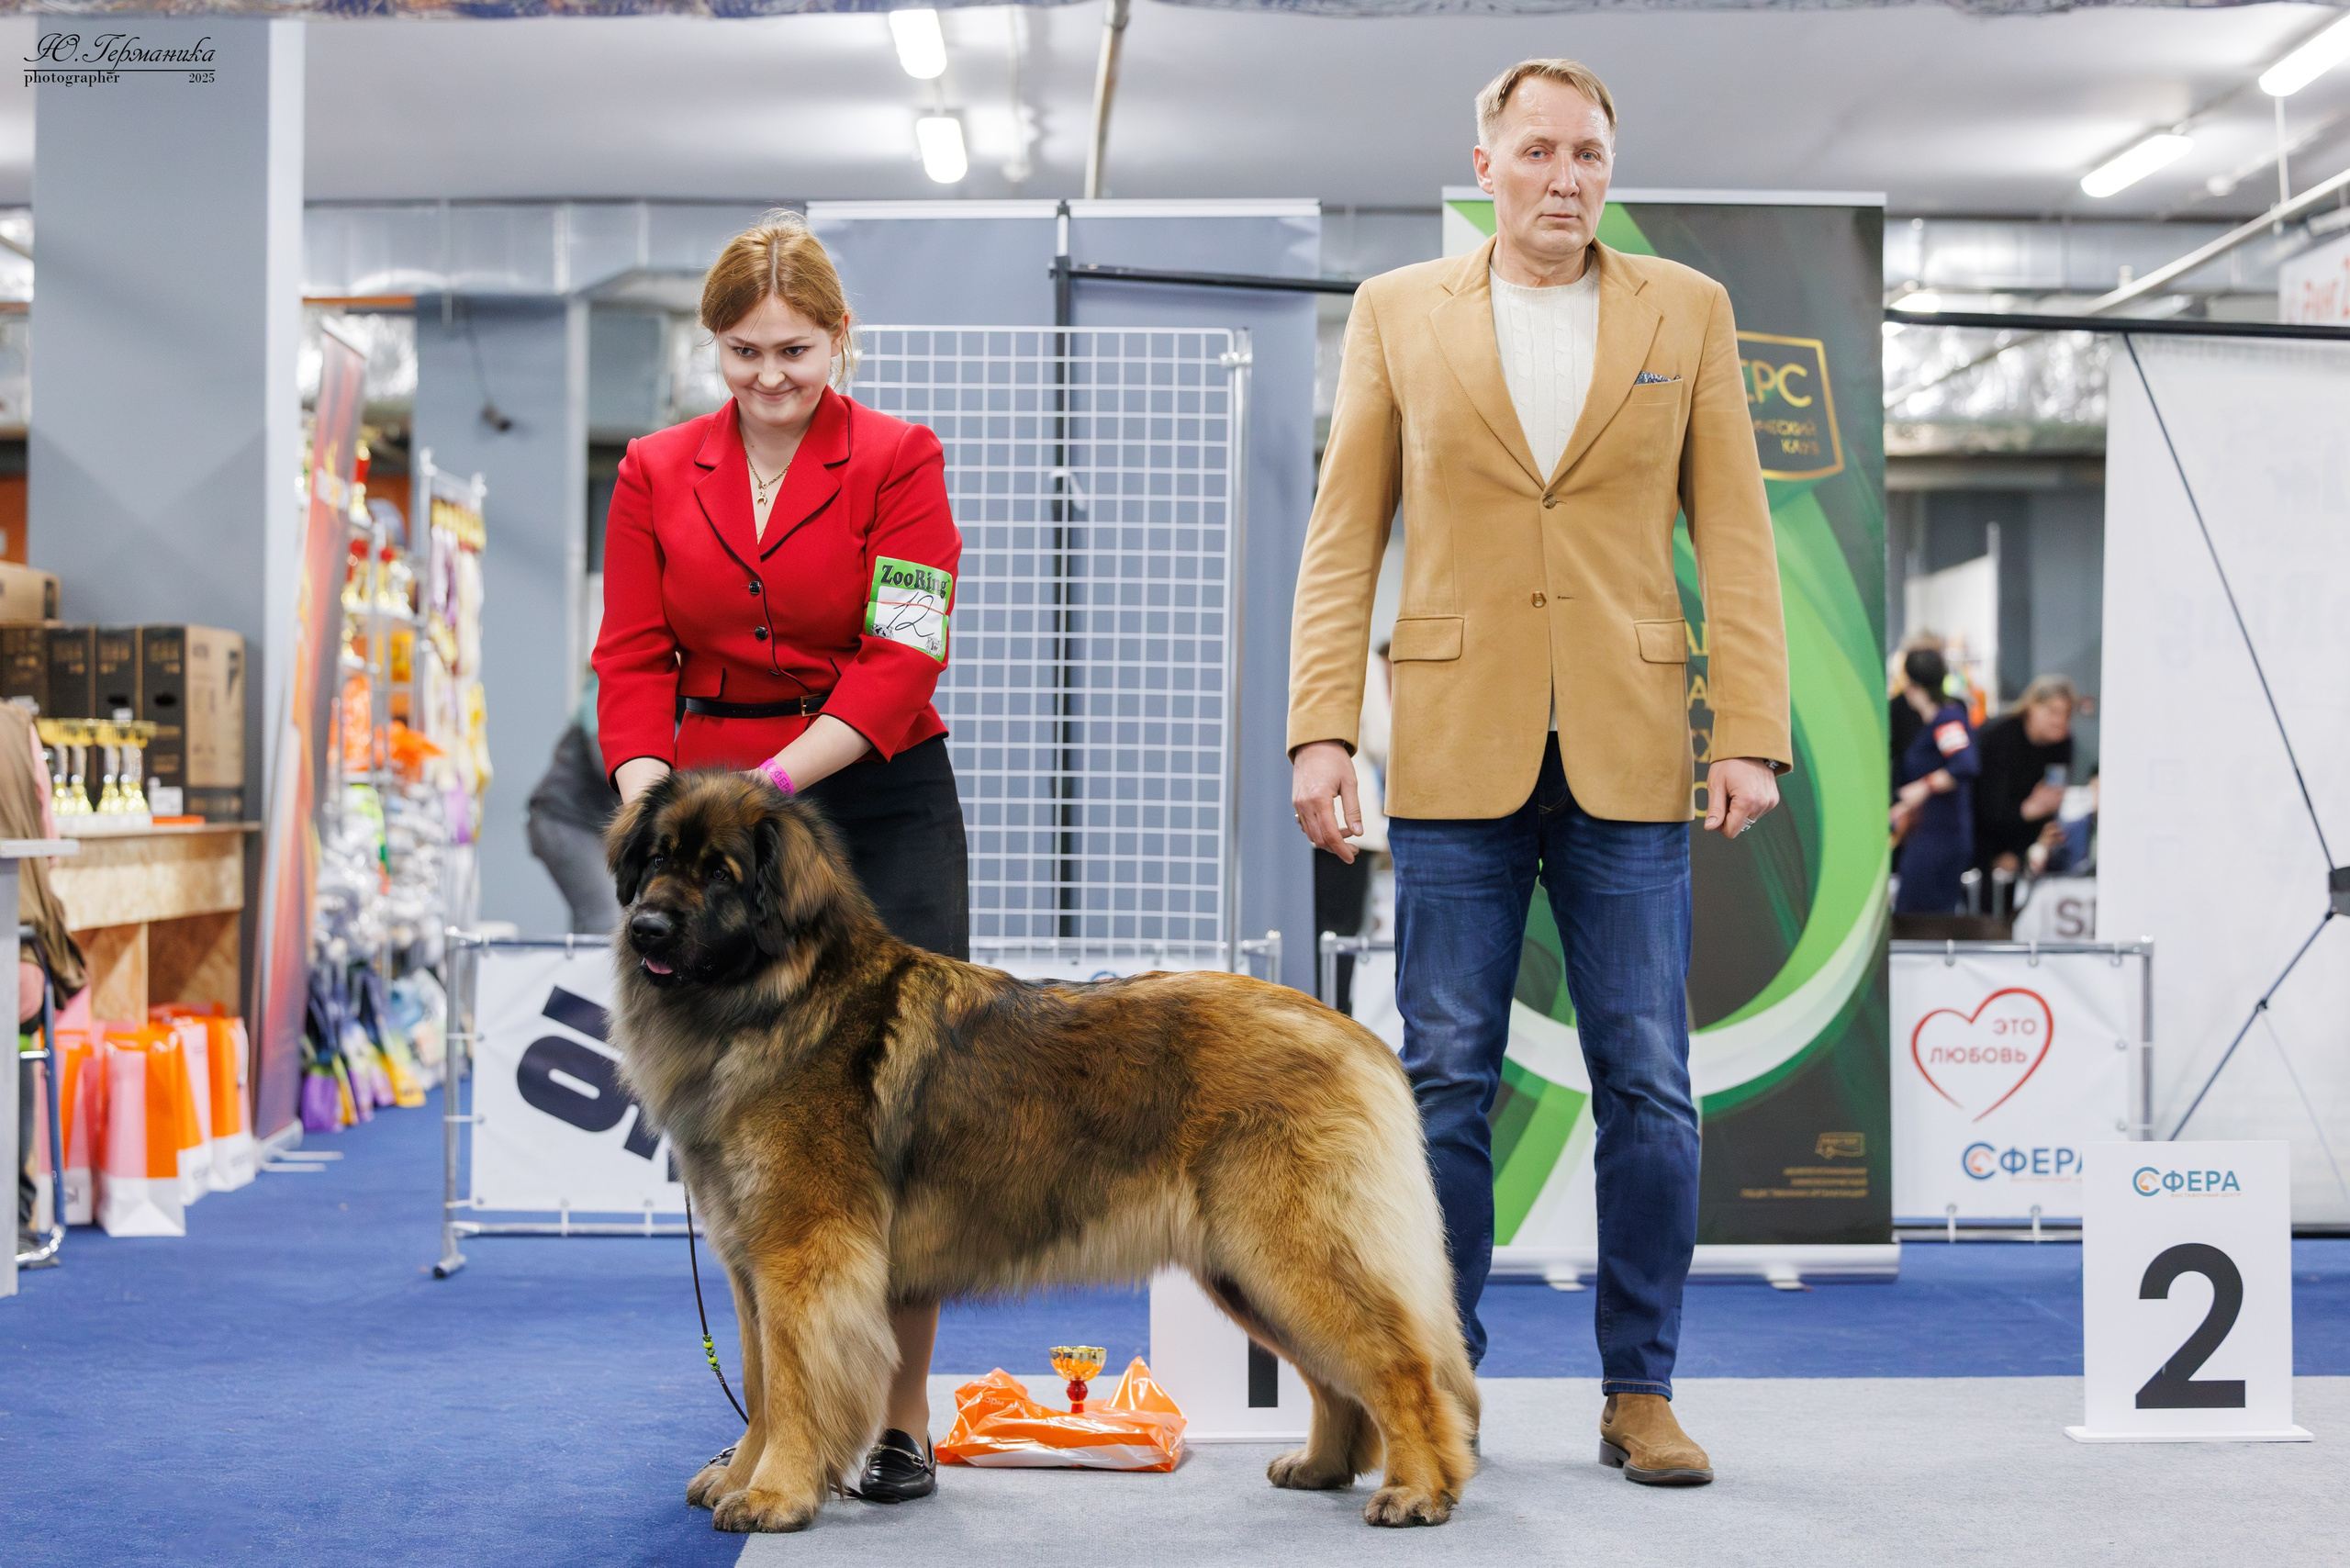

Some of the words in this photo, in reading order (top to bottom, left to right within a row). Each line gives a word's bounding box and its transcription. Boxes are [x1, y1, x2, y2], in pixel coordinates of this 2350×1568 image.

[881, 565, 948, 599] ZooRing
[1993, 1018, 2037, 1036] ЭТО
[1929, 1047, 2028, 1064] ЛЮБОВЬ
[2132, 1166, 2241, 1197] СФЕРА
[2135, 1241, 2246, 1410] 2
